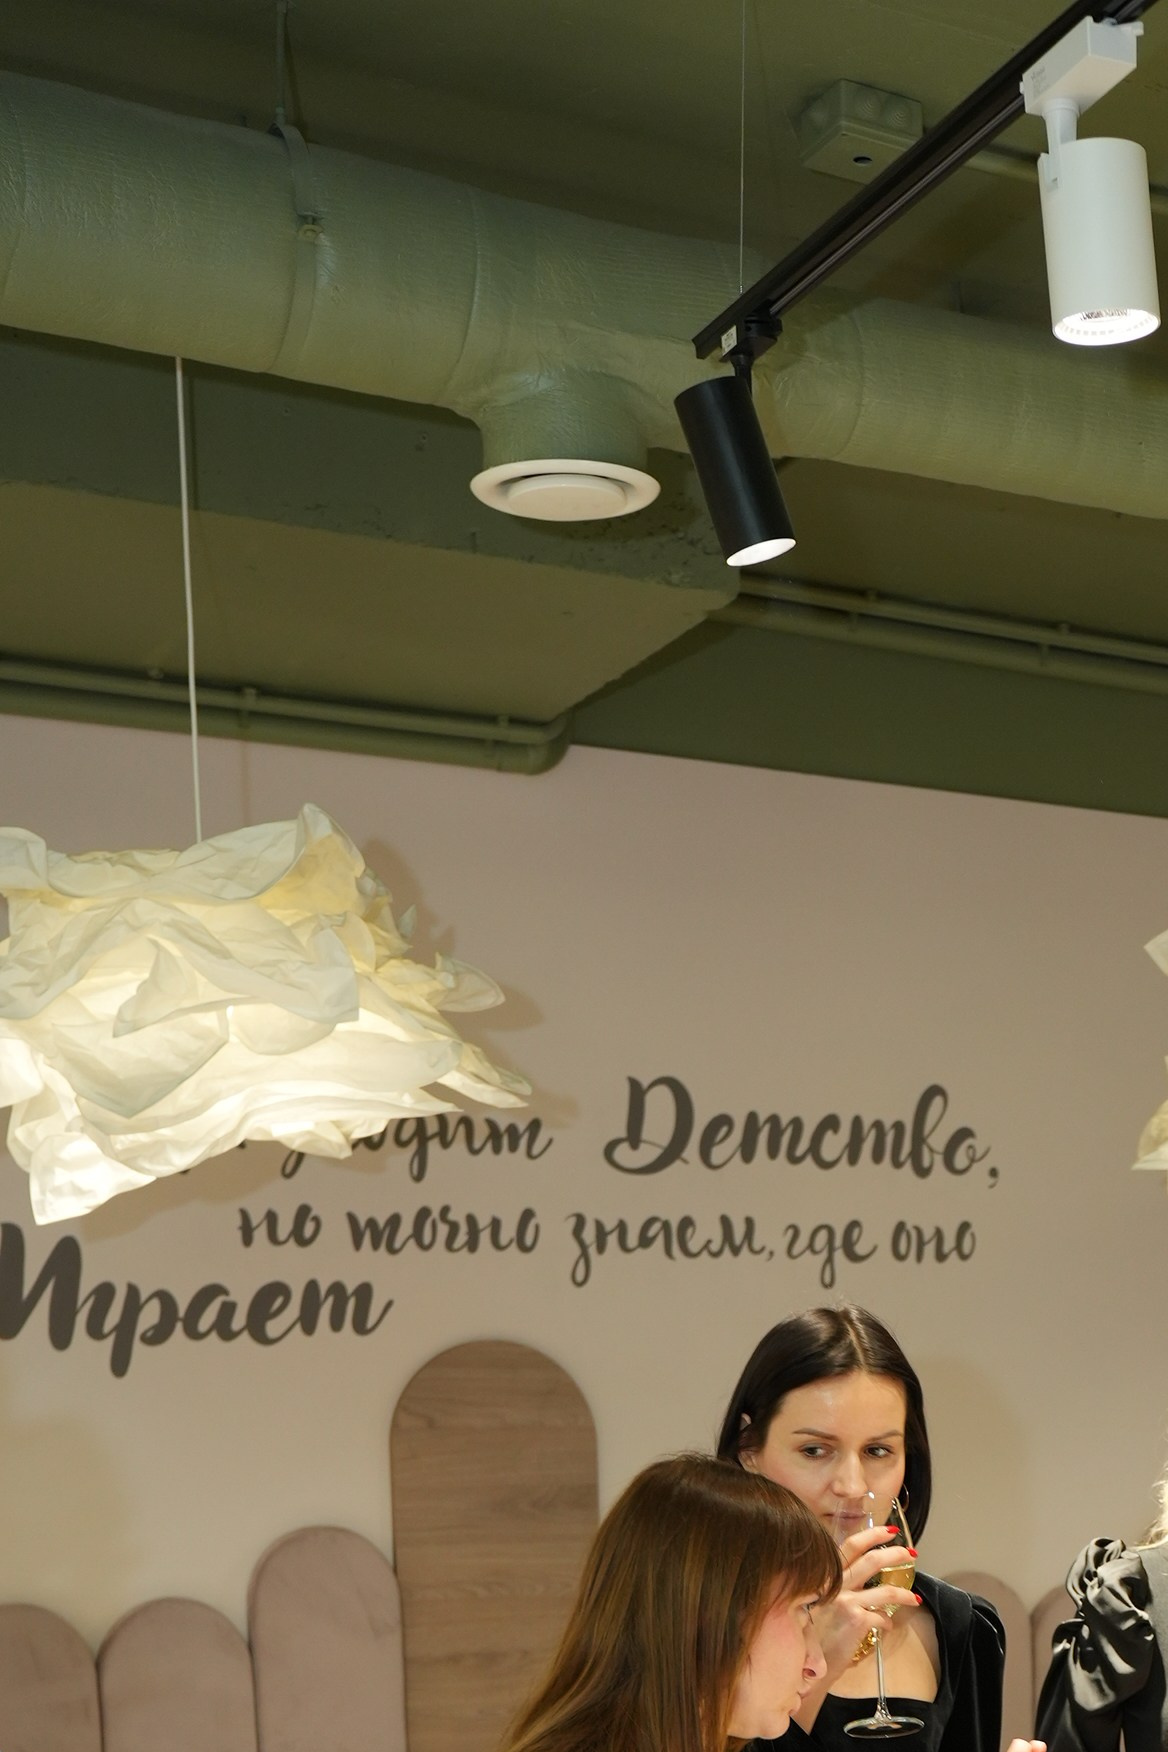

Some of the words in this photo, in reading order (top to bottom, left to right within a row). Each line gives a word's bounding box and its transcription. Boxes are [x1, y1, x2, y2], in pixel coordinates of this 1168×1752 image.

[603, 1075, 999, 1189] Детство,
[0, 1222, 394, 1379] Играет
[237, 1203, 322, 1249] но
[346, 1203, 541, 1255] точно
[783, 1219, 878, 1289] где
[890, 1219, 977, 1265] оно
